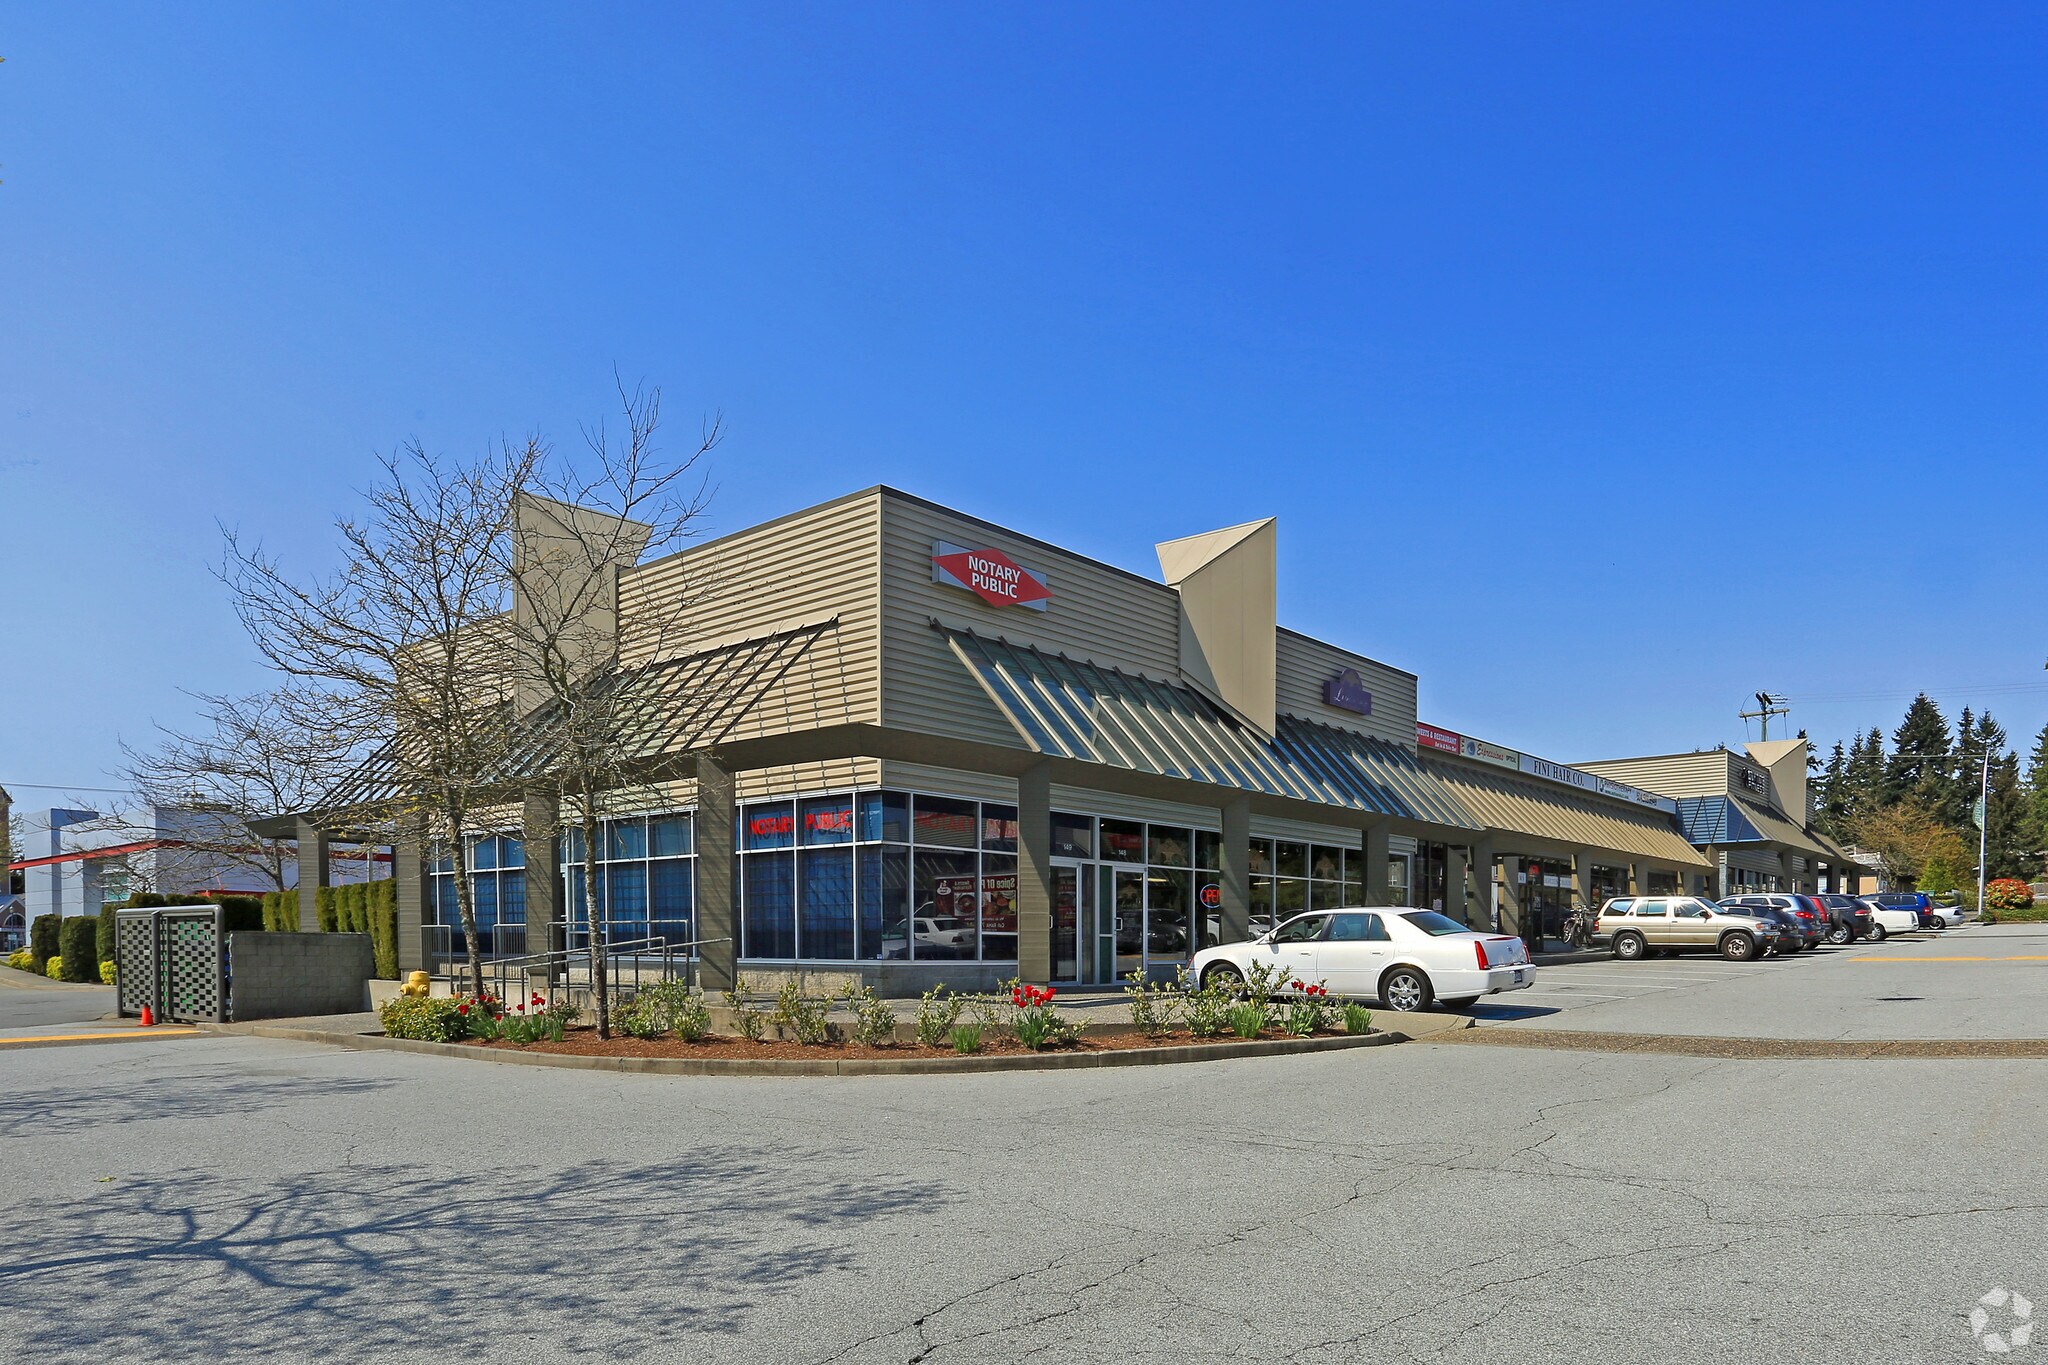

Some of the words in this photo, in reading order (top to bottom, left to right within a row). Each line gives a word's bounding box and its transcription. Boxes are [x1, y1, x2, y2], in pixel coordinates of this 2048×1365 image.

[968, 555, 1021, 584] NOTARY
[971, 572, 1018, 598] PUBLIC
[1533, 760, 1550, 777] FINI
[1553, 766, 1571, 783] HAIR
[1573, 772, 1585, 787] CO.
[749, 815, 794, 835] NOTARY
[805, 809, 852, 831] PUBLIC
[1063, 843, 1073, 851] 149
